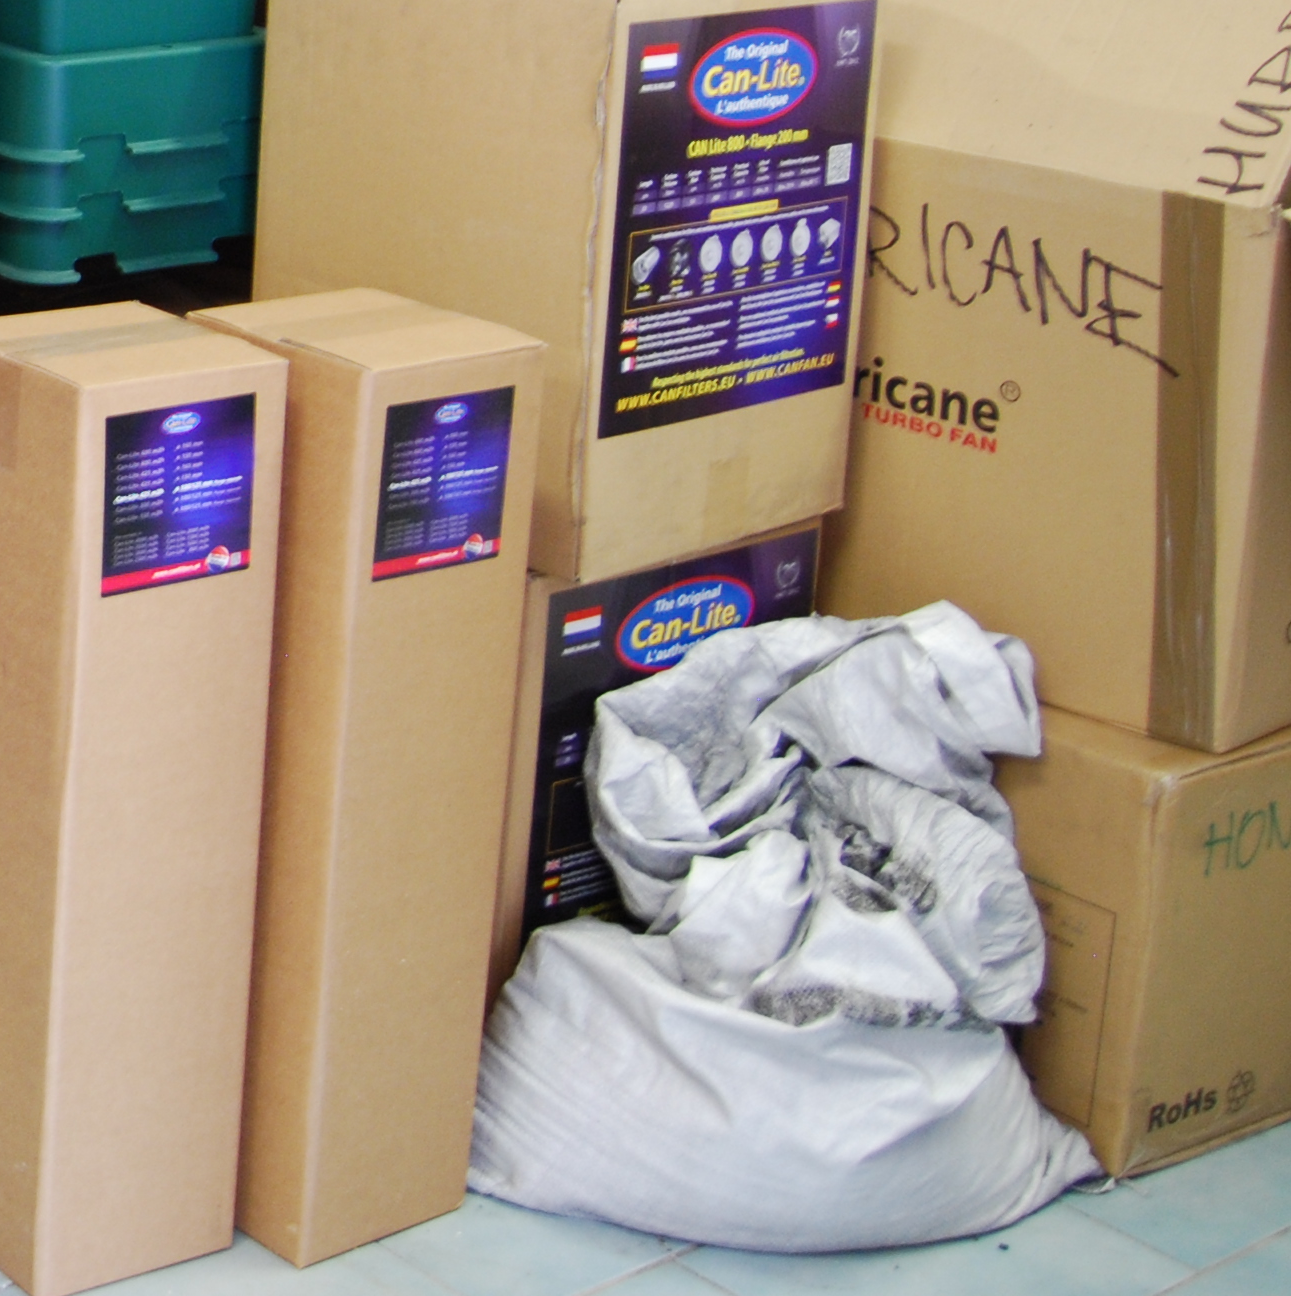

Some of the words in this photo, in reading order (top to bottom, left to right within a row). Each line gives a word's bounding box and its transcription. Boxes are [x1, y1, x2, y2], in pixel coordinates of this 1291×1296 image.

[723, 45, 746, 62] The
[744, 39, 790, 62] Original
[702, 58, 802, 98] Can-Lite
[714, 92, 790, 116] L'authentique
[686, 139, 710, 159] CAN
[870, 202, 1180, 379] RICANE
[615, 374, 737, 414] WWW.CANFILTERS.EU
[744, 352, 835, 386] WWW.CANFAN.EU
[853, 356, 1001, 434] ricane
[863, 404, 944, 439] TURBO
[948, 427, 999, 455] FAN
[653, 597, 675, 615] The
[676, 582, 724, 608] Original
[630, 604, 737, 650] Can-Lite
[1147, 1088, 1219, 1134] RoHs
